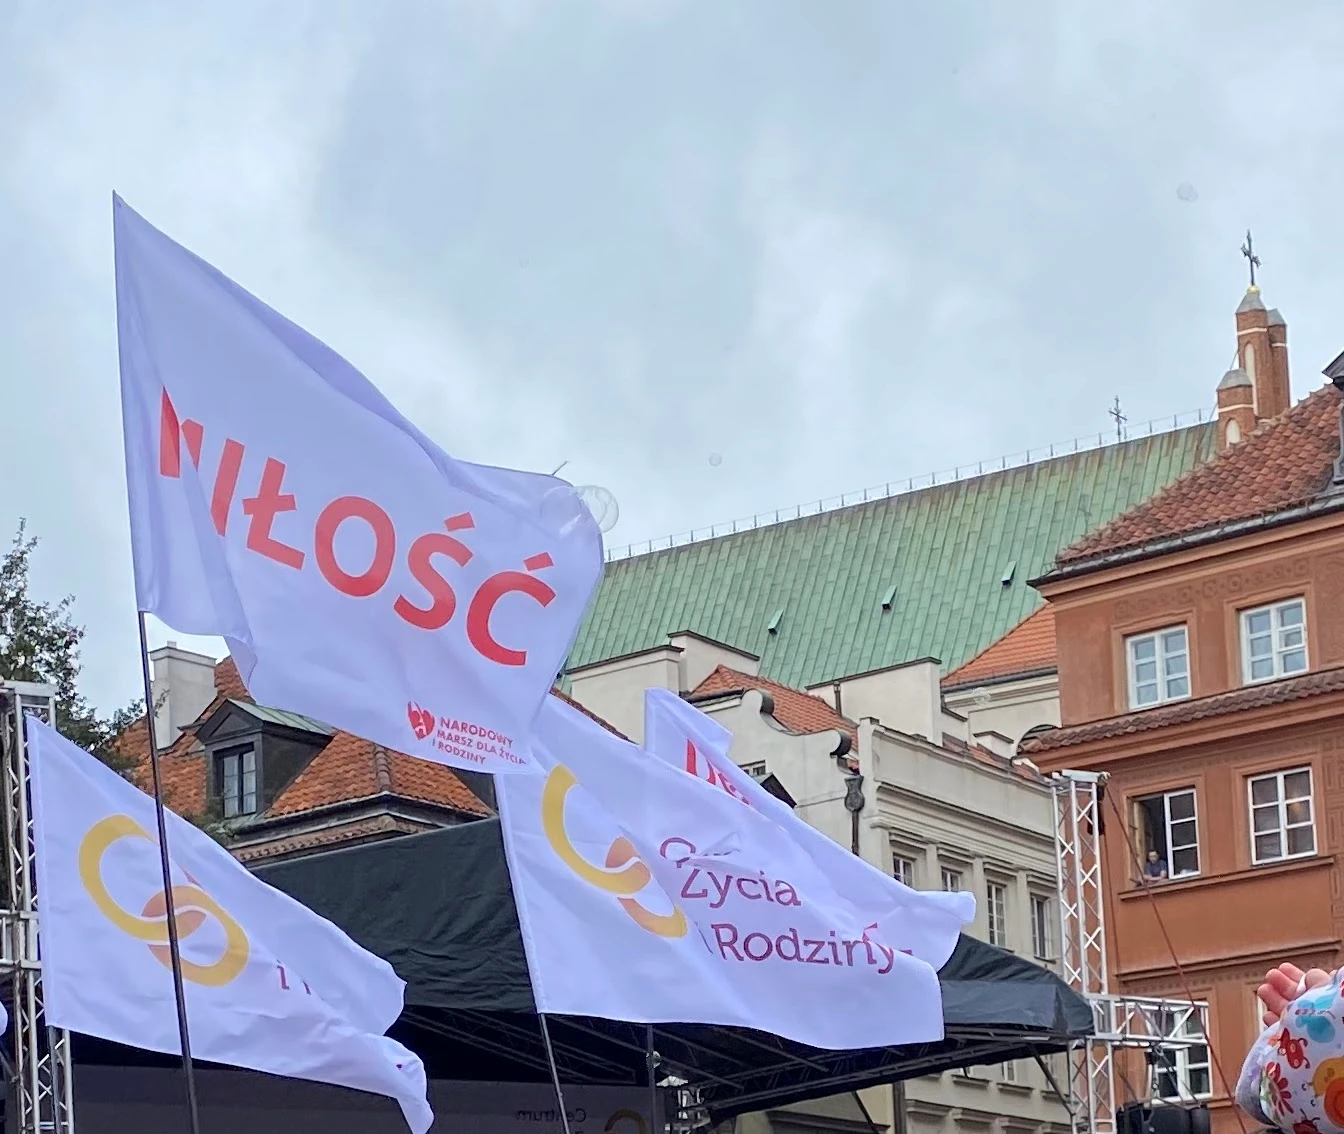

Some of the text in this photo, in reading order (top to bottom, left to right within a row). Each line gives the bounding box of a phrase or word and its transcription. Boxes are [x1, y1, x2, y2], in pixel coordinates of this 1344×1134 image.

[437, 729, 473, 748] MARSZ
[477, 741, 498, 755] DLA
[440, 716, 513, 749] NARODOWY
[432, 738, 486, 765] I RODZINY
